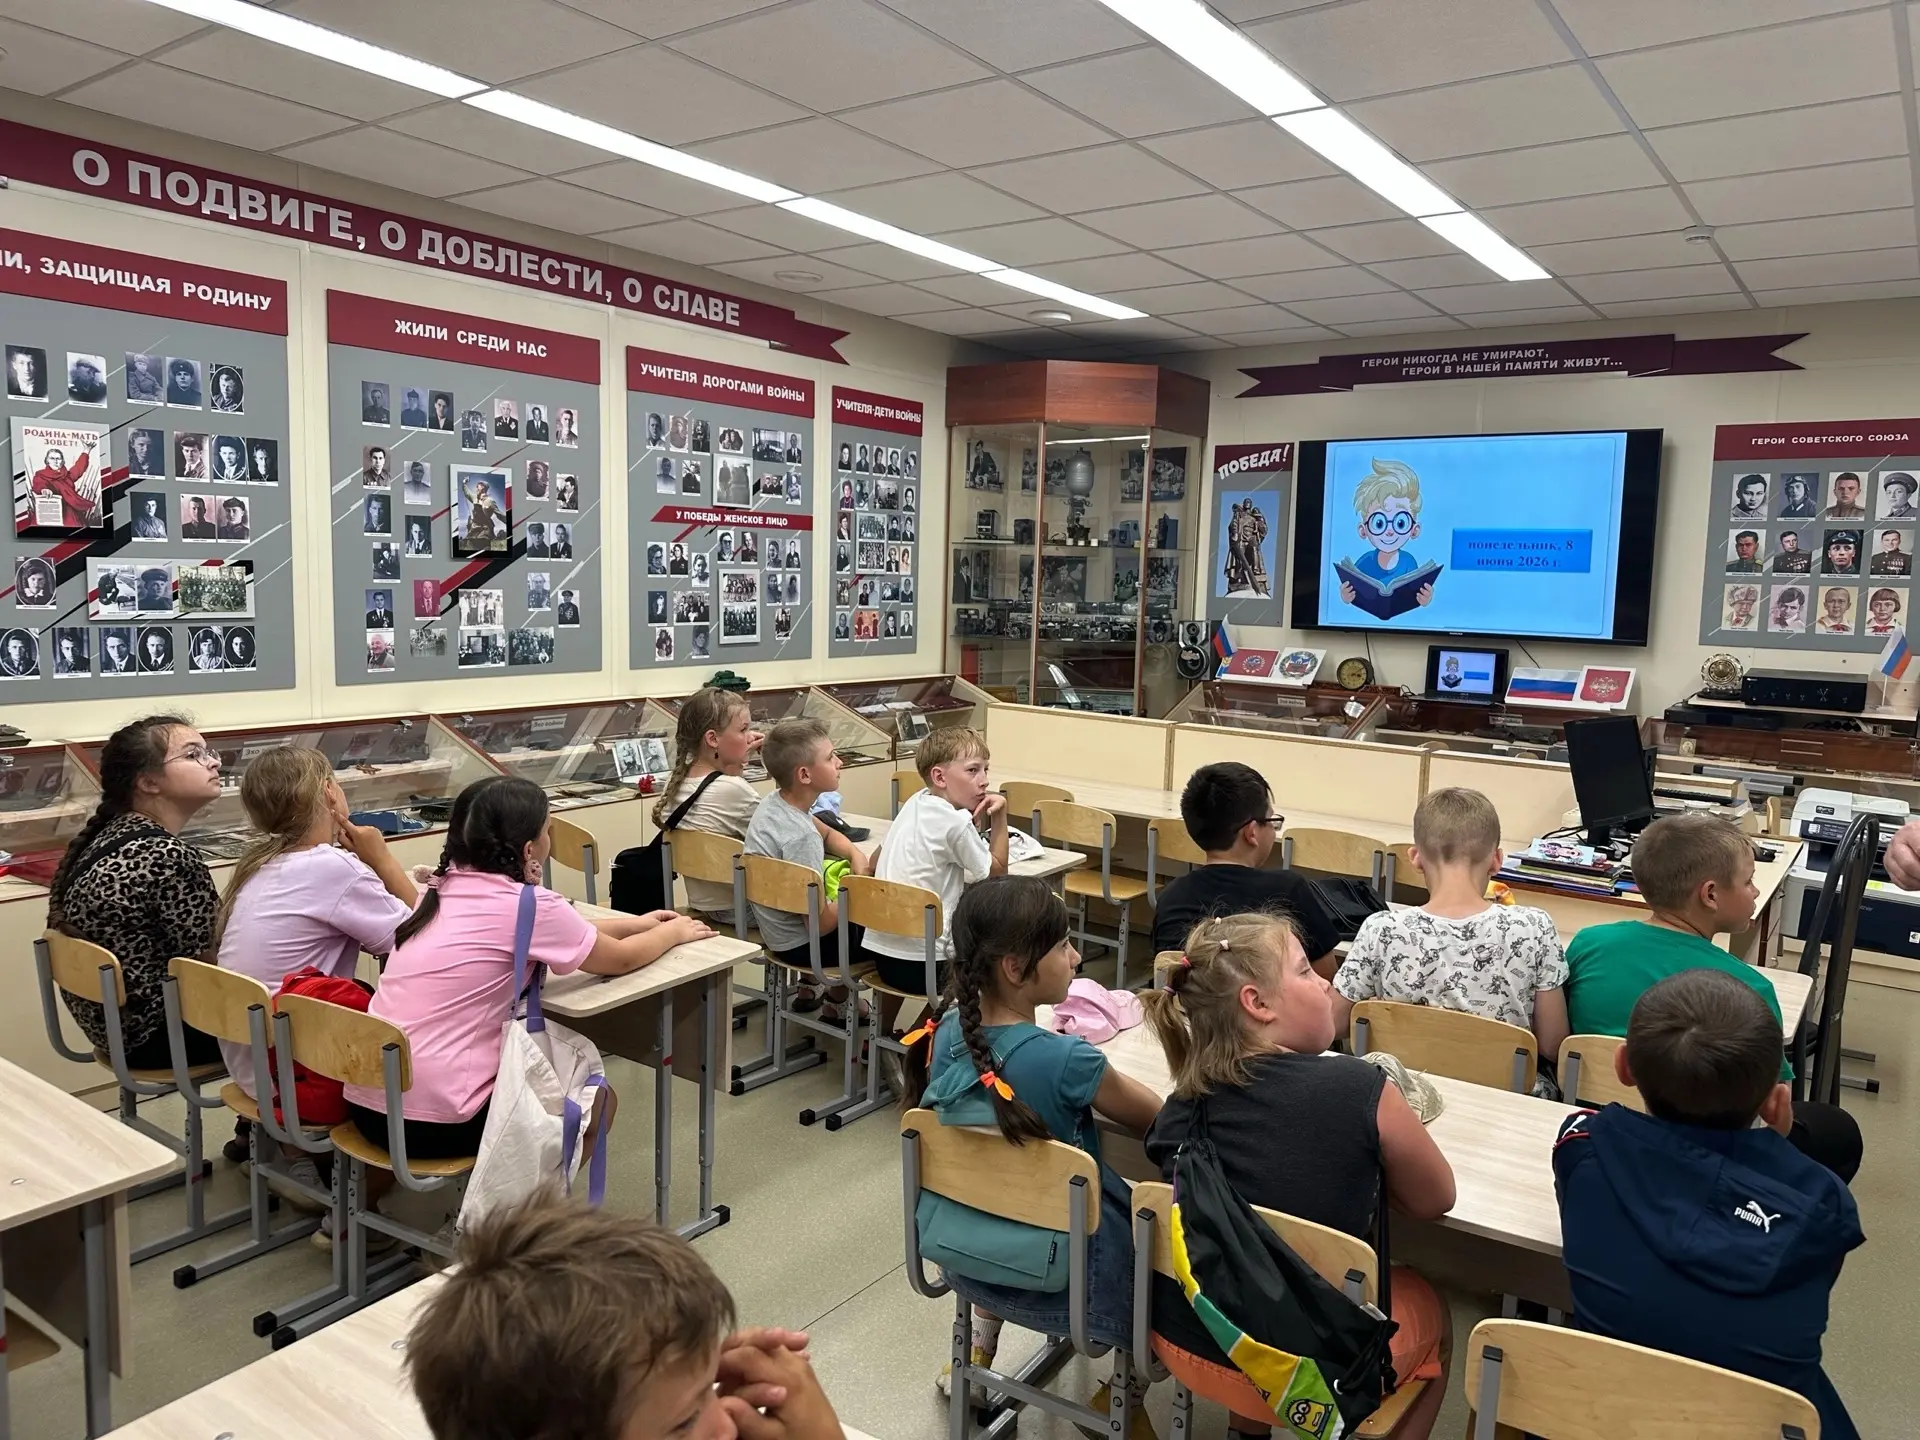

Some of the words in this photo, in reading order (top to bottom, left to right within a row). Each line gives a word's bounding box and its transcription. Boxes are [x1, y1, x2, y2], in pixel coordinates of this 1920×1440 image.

[72, 149, 110, 186] О
[128, 160, 367, 251] ПОДВИГЕ,
[379, 220, 406, 251] О
[417, 229, 612, 302] ДОБЛЕСТИ,
[623, 277, 643, 303] О
[653, 283, 740, 327] СЛАВЕ
[39, 257, 171, 293] ЗАЩИЩАЯ
[183, 281, 272, 311] РОДИНУ
[395, 319, 448, 340] ЖИЛИ
[456, 331, 510, 351] СРЕДИ
[516, 341, 547, 357] НАС
[1362, 356, 1399, 367] ГЕРОИ
[1403, 353, 1458, 365] НИКОГДА
[1462, 352, 1478, 362] НЕ
[1482, 348, 1550, 360] УМИРАЮТ,
[1402, 366, 1440, 376] ГЕРОИ
[1444, 364, 1452, 373] В
[1456, 360, 1500, 373] НАШЕЙ
[1505, 359, 1558, 370] ПАМЯТИ
[1563, 357, 1623, 368] ЖИВУТ...
[640, 362, 697, 384] УЧИТЕЛЯ
[702, 374, 764, 395] ДОРОГАМИ
[767, 386, 805, 402] ВОЙНЫ
[24, 428, 98, 440] РОДИНА-МАТЬ
[44, 439, 78, 447] ЗОВЕТ!
[1751, 437, 1785, 445] ГЕРОИ
[1791, 435, 1863, 444] СОВЕТСКОГО
[1868, 433, 1909, 441] СОЮЗА
[1217, 444, 1290, 480] ПОБЕДА!
[676, 510, 682, 519] У
[683, 512, 721, 522] ПОБЕДЫ
[724, 514, 763, 524] ЖЕНСКОЕ
[765, 516, 788, 526] ЛИЦО
[1468, 540, 1562, 551] понедельник,
[1566, 540, 1573, 550] 8
[1477, 557, 1513, 566] июня
[1518, 556, 1549, 567] 2026
[1734, 1207, 1763, 1226] PUMA
